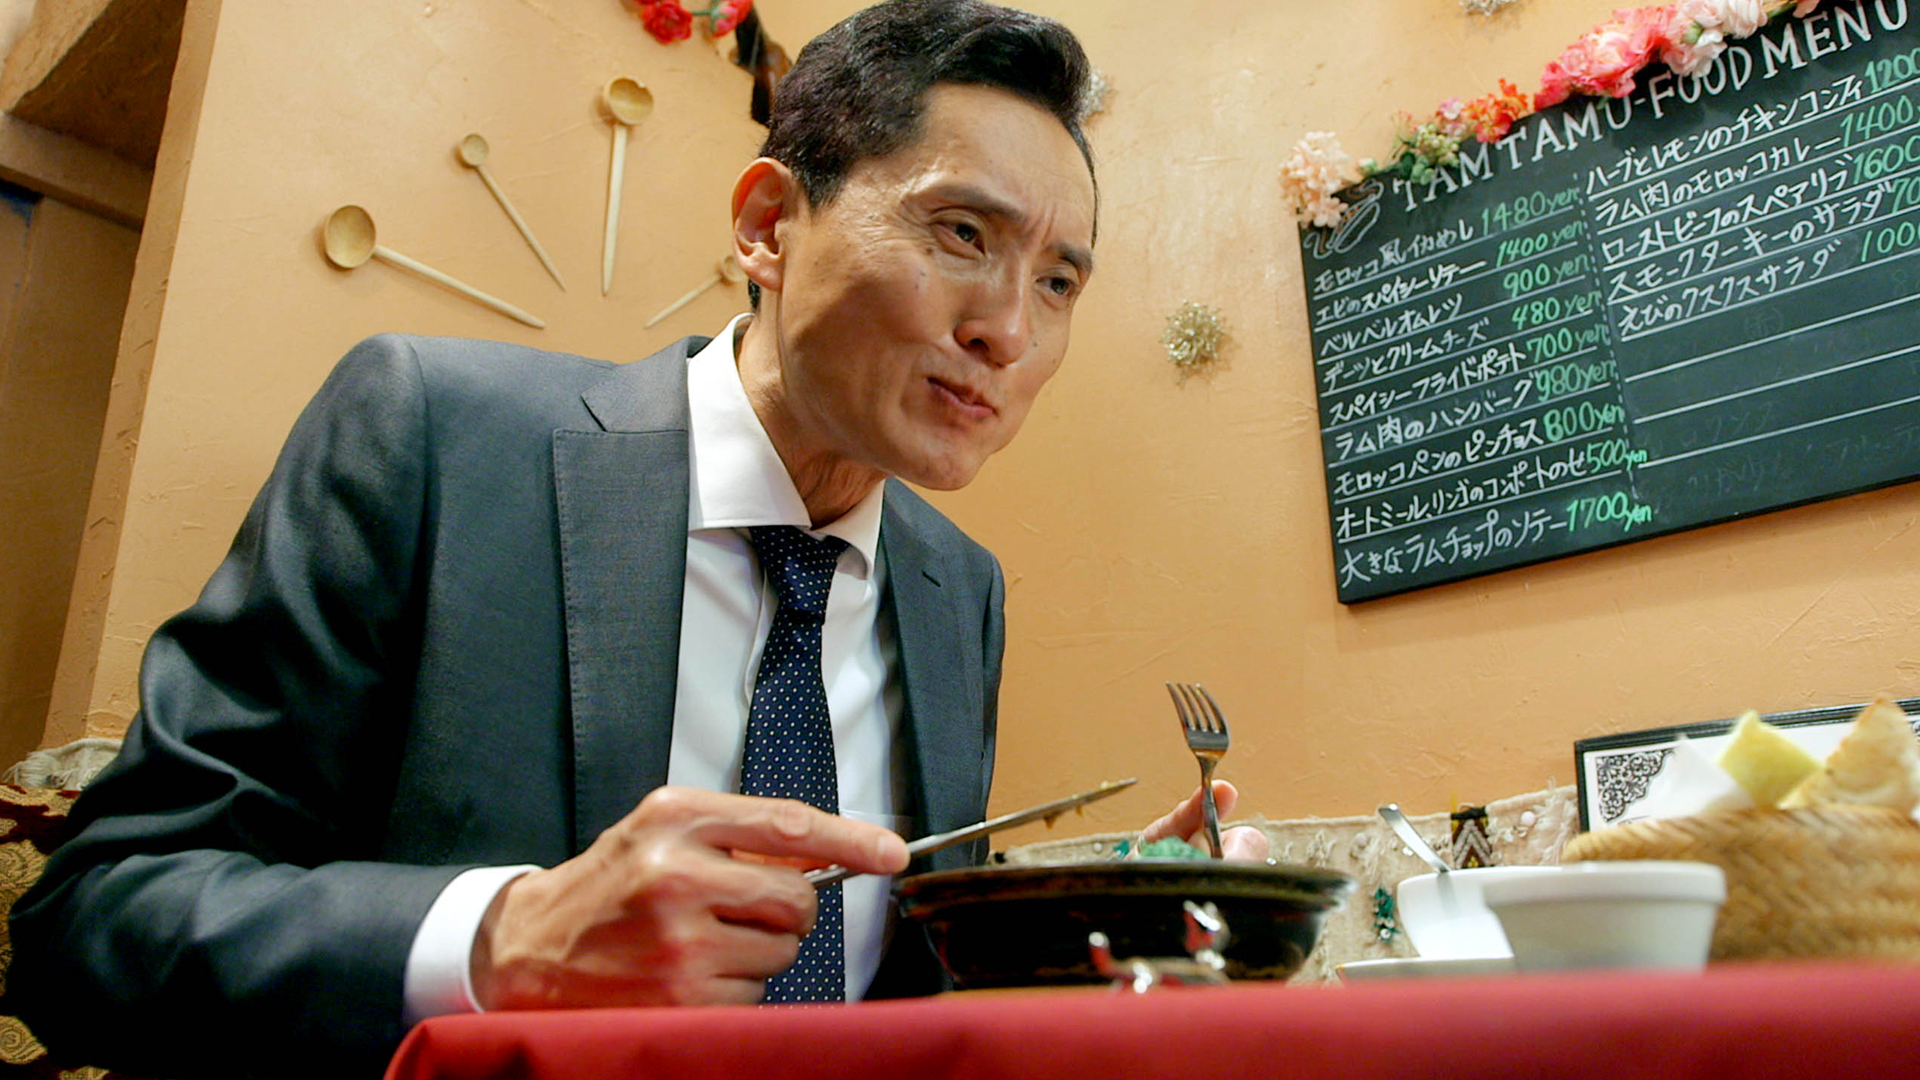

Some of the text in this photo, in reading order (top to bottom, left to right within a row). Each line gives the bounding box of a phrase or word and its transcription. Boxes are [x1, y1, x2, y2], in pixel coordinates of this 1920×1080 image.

[1595, 137, 1841, 227] ラム肉のモロッコカレー
[1313, 219, 1474, 293] モロッコ風イカめし
[1618, 239, 1842, 336] えびのクスクスサラダ
[1323, 317, 1489, 391] デーツとクリームチーズ
[1329, 342, 1526, 426] スパイシーフライドポテト
[1335, 371, 1539, 460] ラム肉のハンバーグ
[1334, 418, 1544, 496] モロッコパンのピンチョス
[1341, 508, 1567, 588] 大きなラムチョップのソテー
